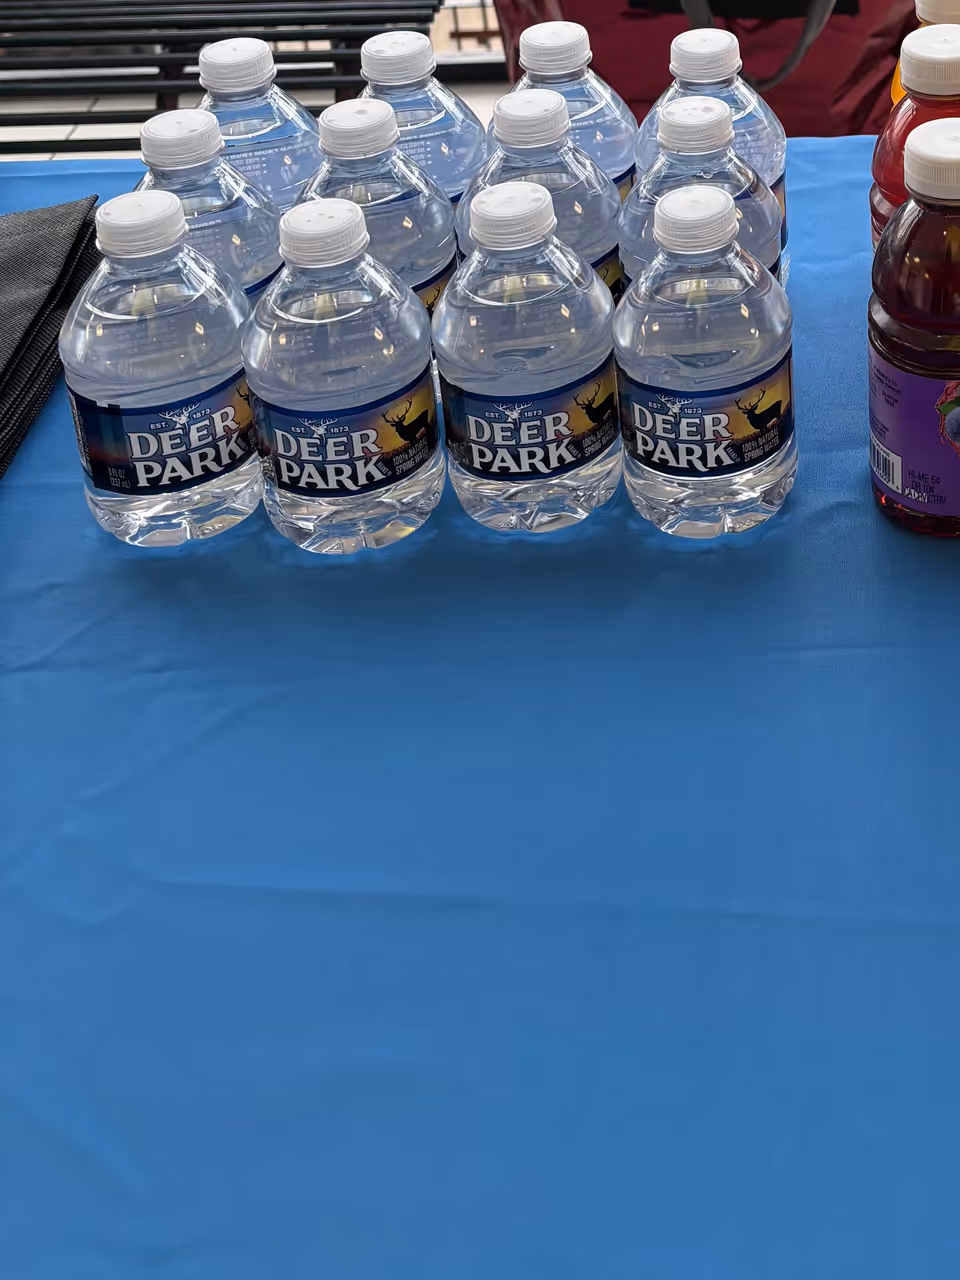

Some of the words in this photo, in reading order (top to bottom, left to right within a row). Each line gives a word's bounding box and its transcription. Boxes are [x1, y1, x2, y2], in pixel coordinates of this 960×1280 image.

[150, 421, 169, 430] EST.
[192, 408, 211, 420] 1873
[485, 411, 501, 419] EST.
[524, 409, 543, 417] 1873
[632, 402, 734, 441] DEER
[648, 402, 663, 410] EST.
[127, 405, 240, 459] DEER
[274, 428, 383, 461] DEER
[291, 426, 307, 434] EST.
[330, 426, 349, 434] 1873
[467, 411, 574, 446] DEER
[131, 431, 246, 487] PARK
[470, 436, 577, 473] PARK
[635, 429, 737, 472] PARK
[742, 440, 758, 452] 100%
[744, 446, 764, 462] SPRING
[763, 435, 780, 452] WATER
[279, 454, 389, 491] PARK
